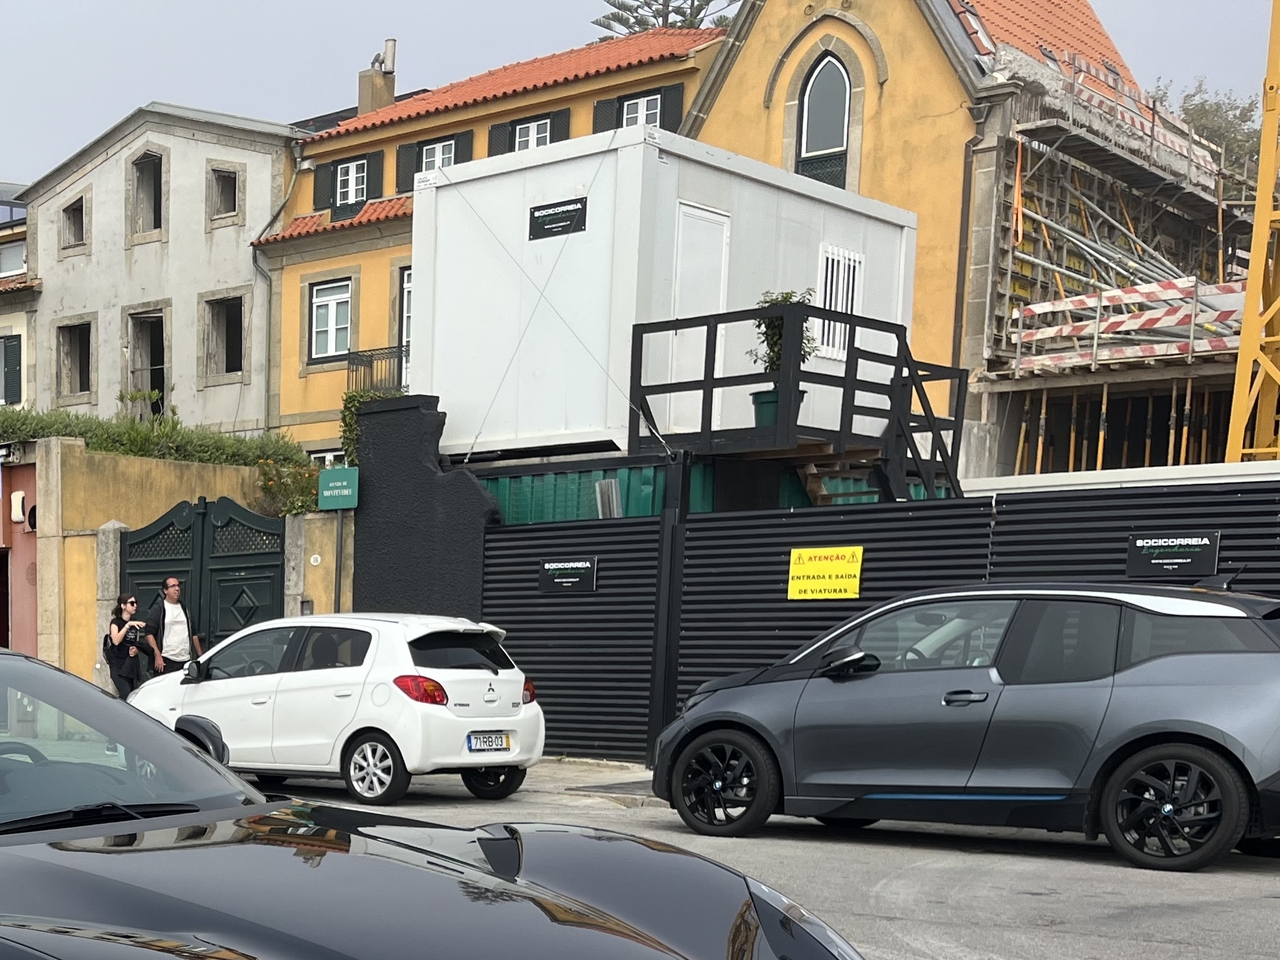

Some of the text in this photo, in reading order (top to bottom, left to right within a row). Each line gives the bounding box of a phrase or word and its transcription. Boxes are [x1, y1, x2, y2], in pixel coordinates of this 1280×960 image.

[534, 203, 582, 217] SOCICORREIA
[1136, 538, 1210, 547] SOCICORREIA
[808, 553, 846, 562] ATENÇÃO
